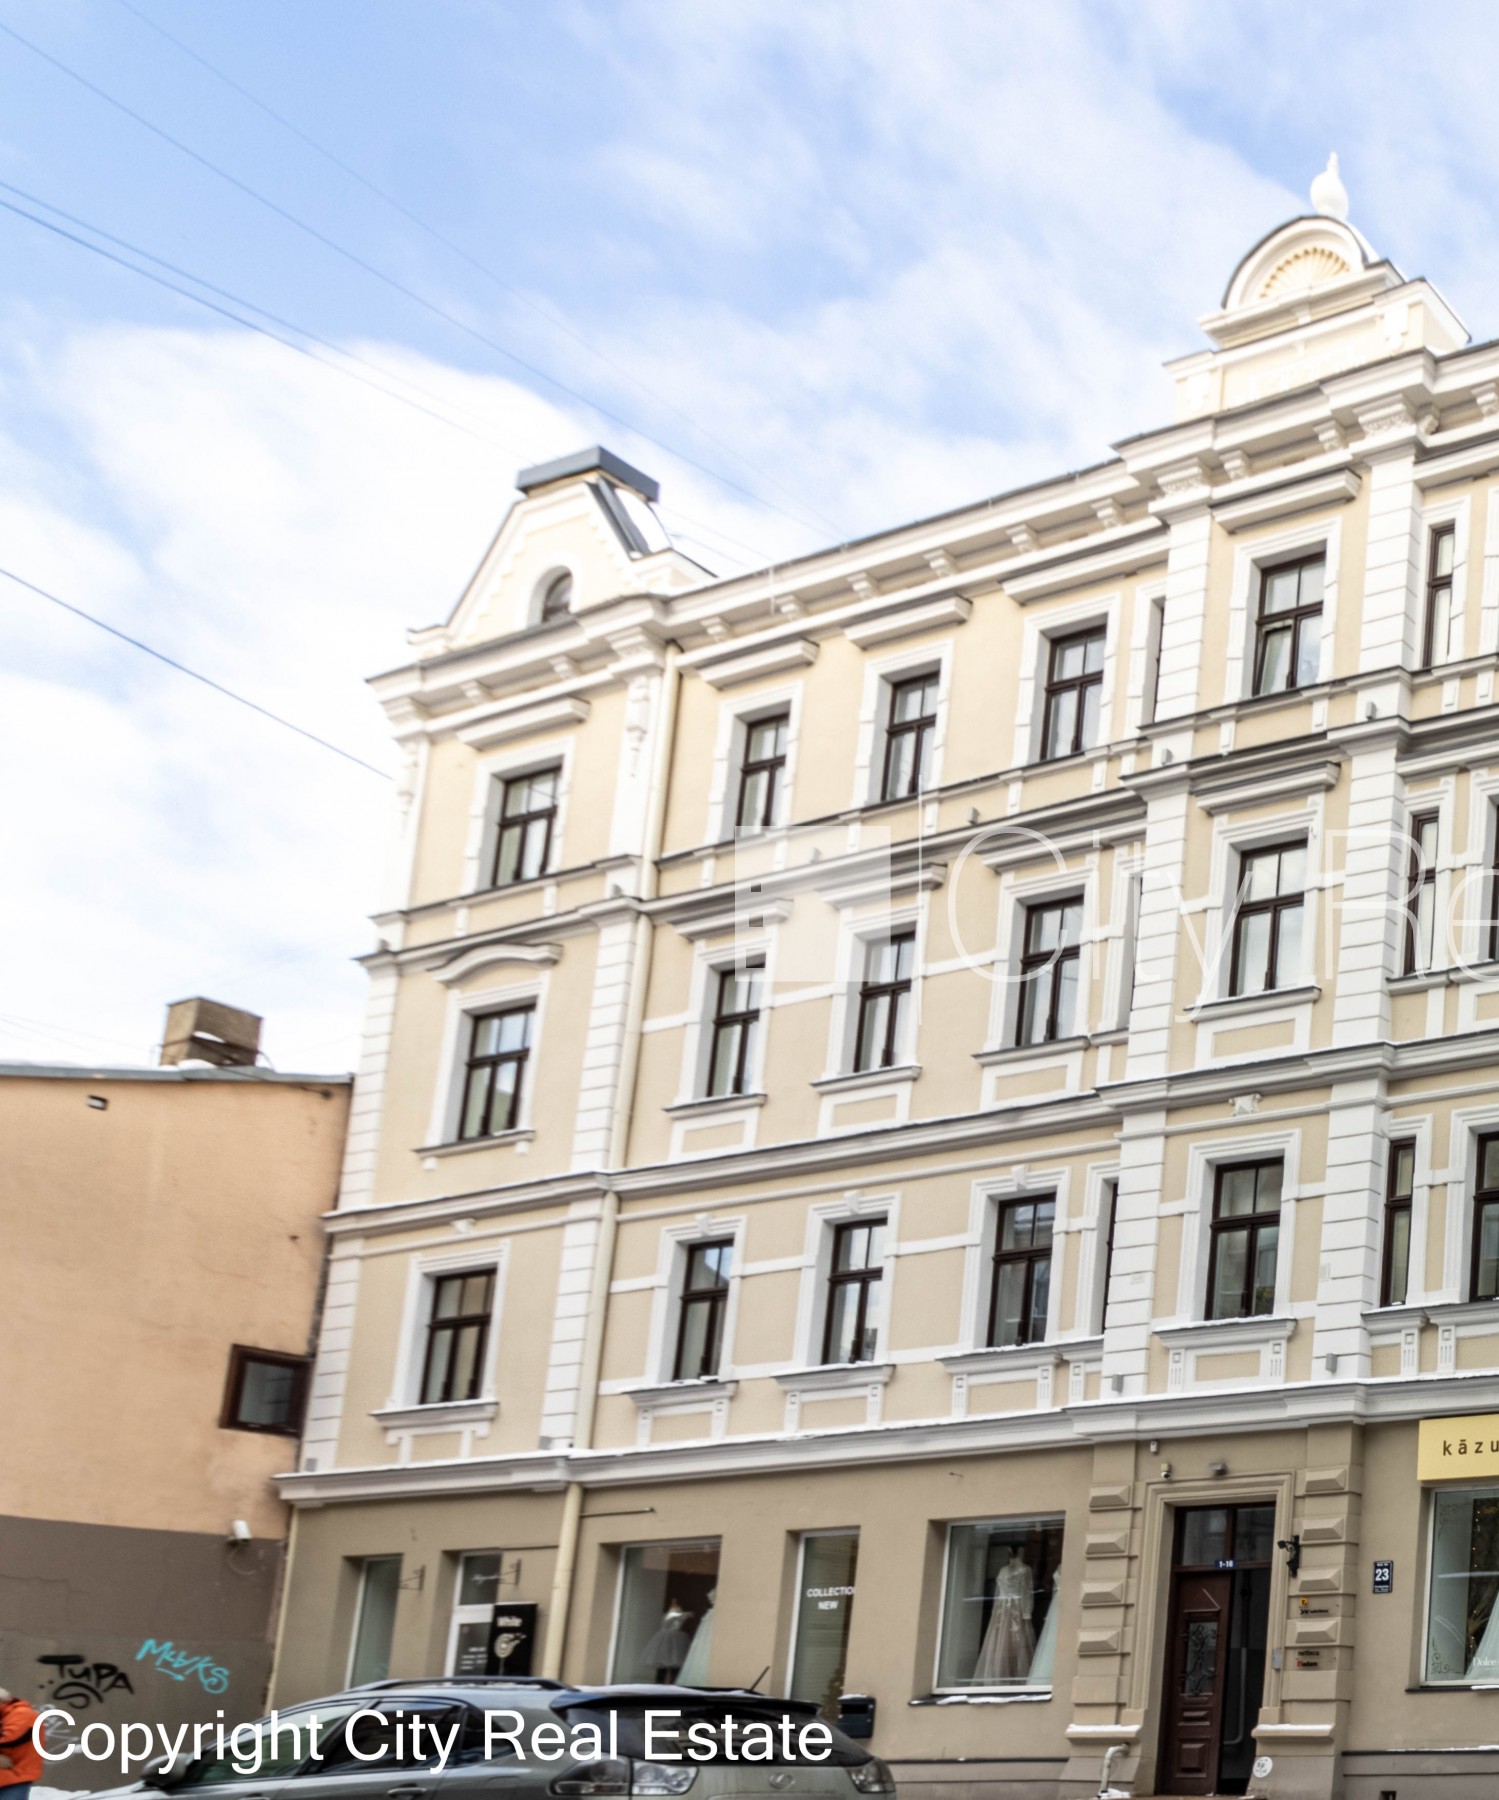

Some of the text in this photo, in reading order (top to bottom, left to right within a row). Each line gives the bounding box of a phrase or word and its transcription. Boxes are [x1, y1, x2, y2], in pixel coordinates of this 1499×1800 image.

[1442, 1439, 1499, 1456] kāzu
[1375, 1568, 1390, 1581] 23
[806, 1586, 854, 1598] COLLECTIO
[817, 1600, 839, 1610] NEW
